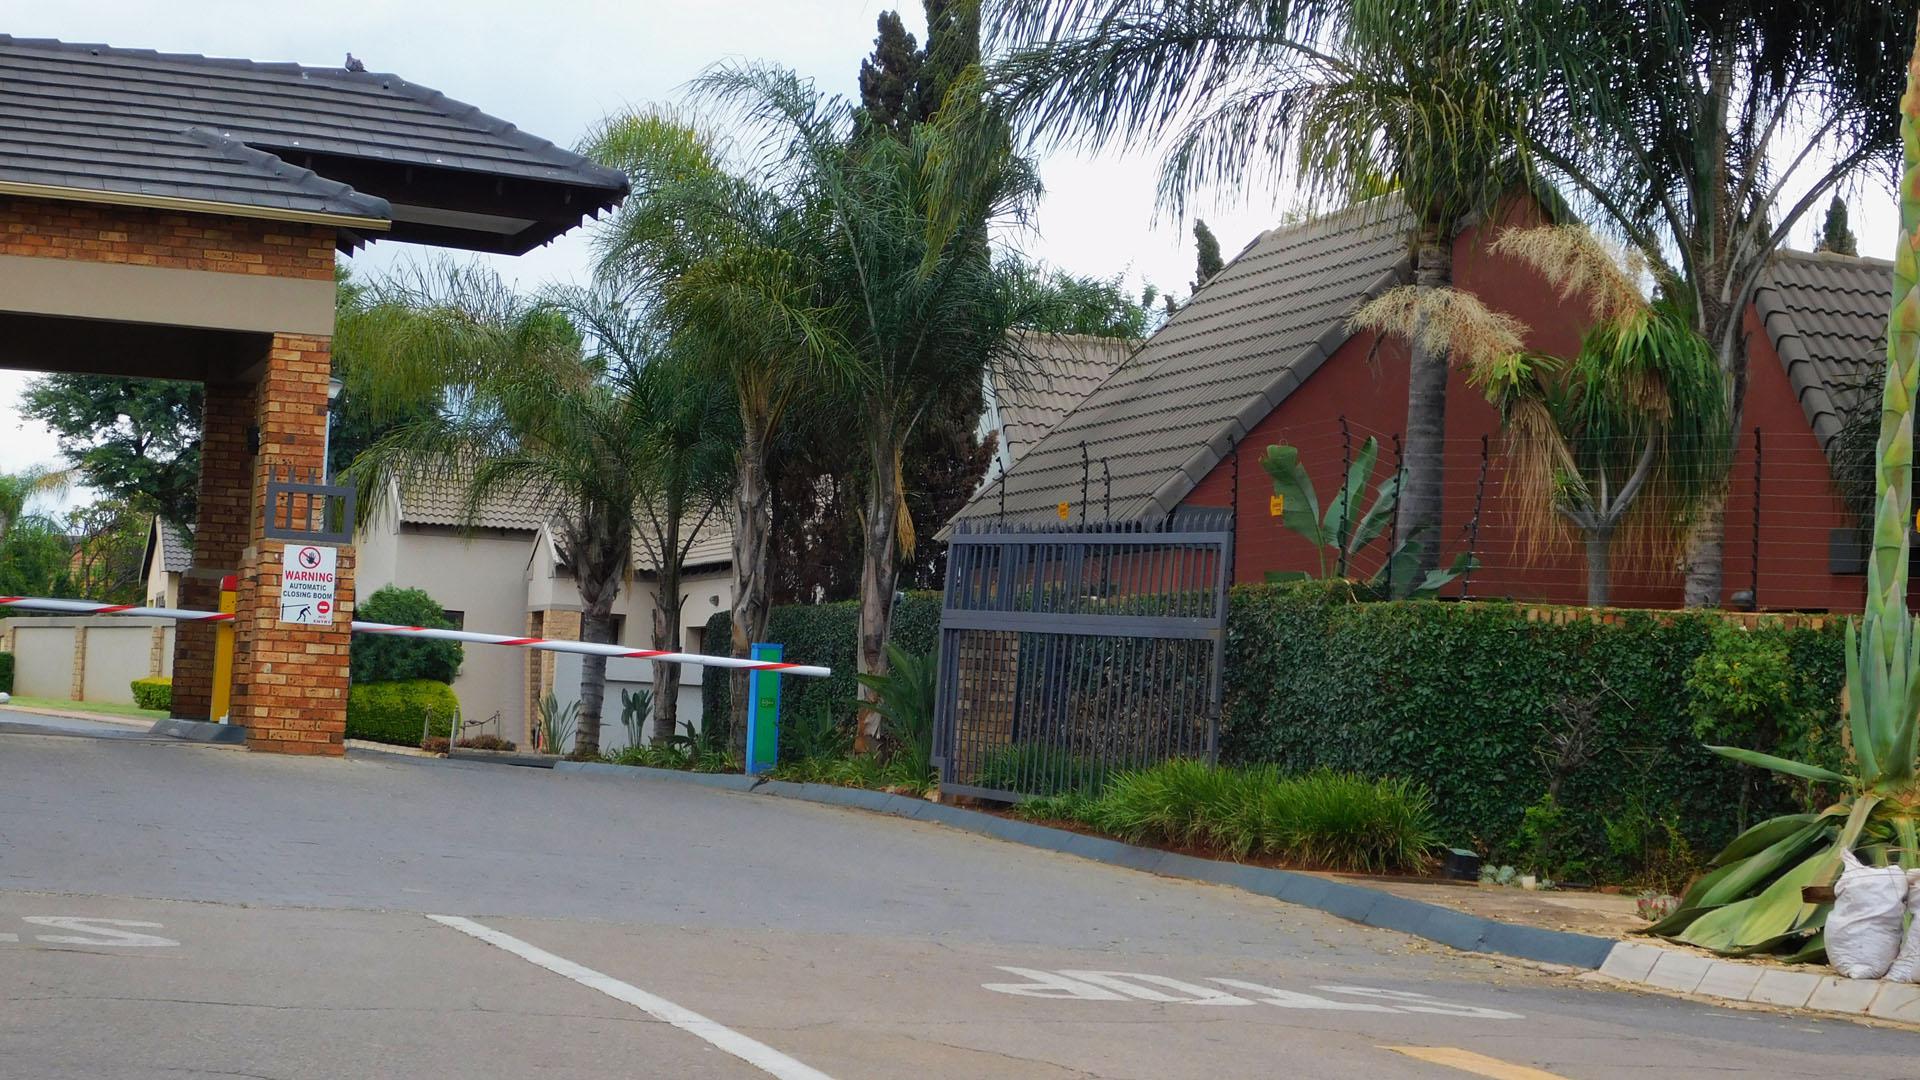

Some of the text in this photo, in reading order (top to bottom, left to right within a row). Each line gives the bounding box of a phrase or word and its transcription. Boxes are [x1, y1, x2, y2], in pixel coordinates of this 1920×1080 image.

[285, 570, 333, 582] WARNING
[290, 583, 326, 591] AUTOMATIC
[283, 590, 311, 598] CLOSING
[981, 965, 1526, 1019] STOP
